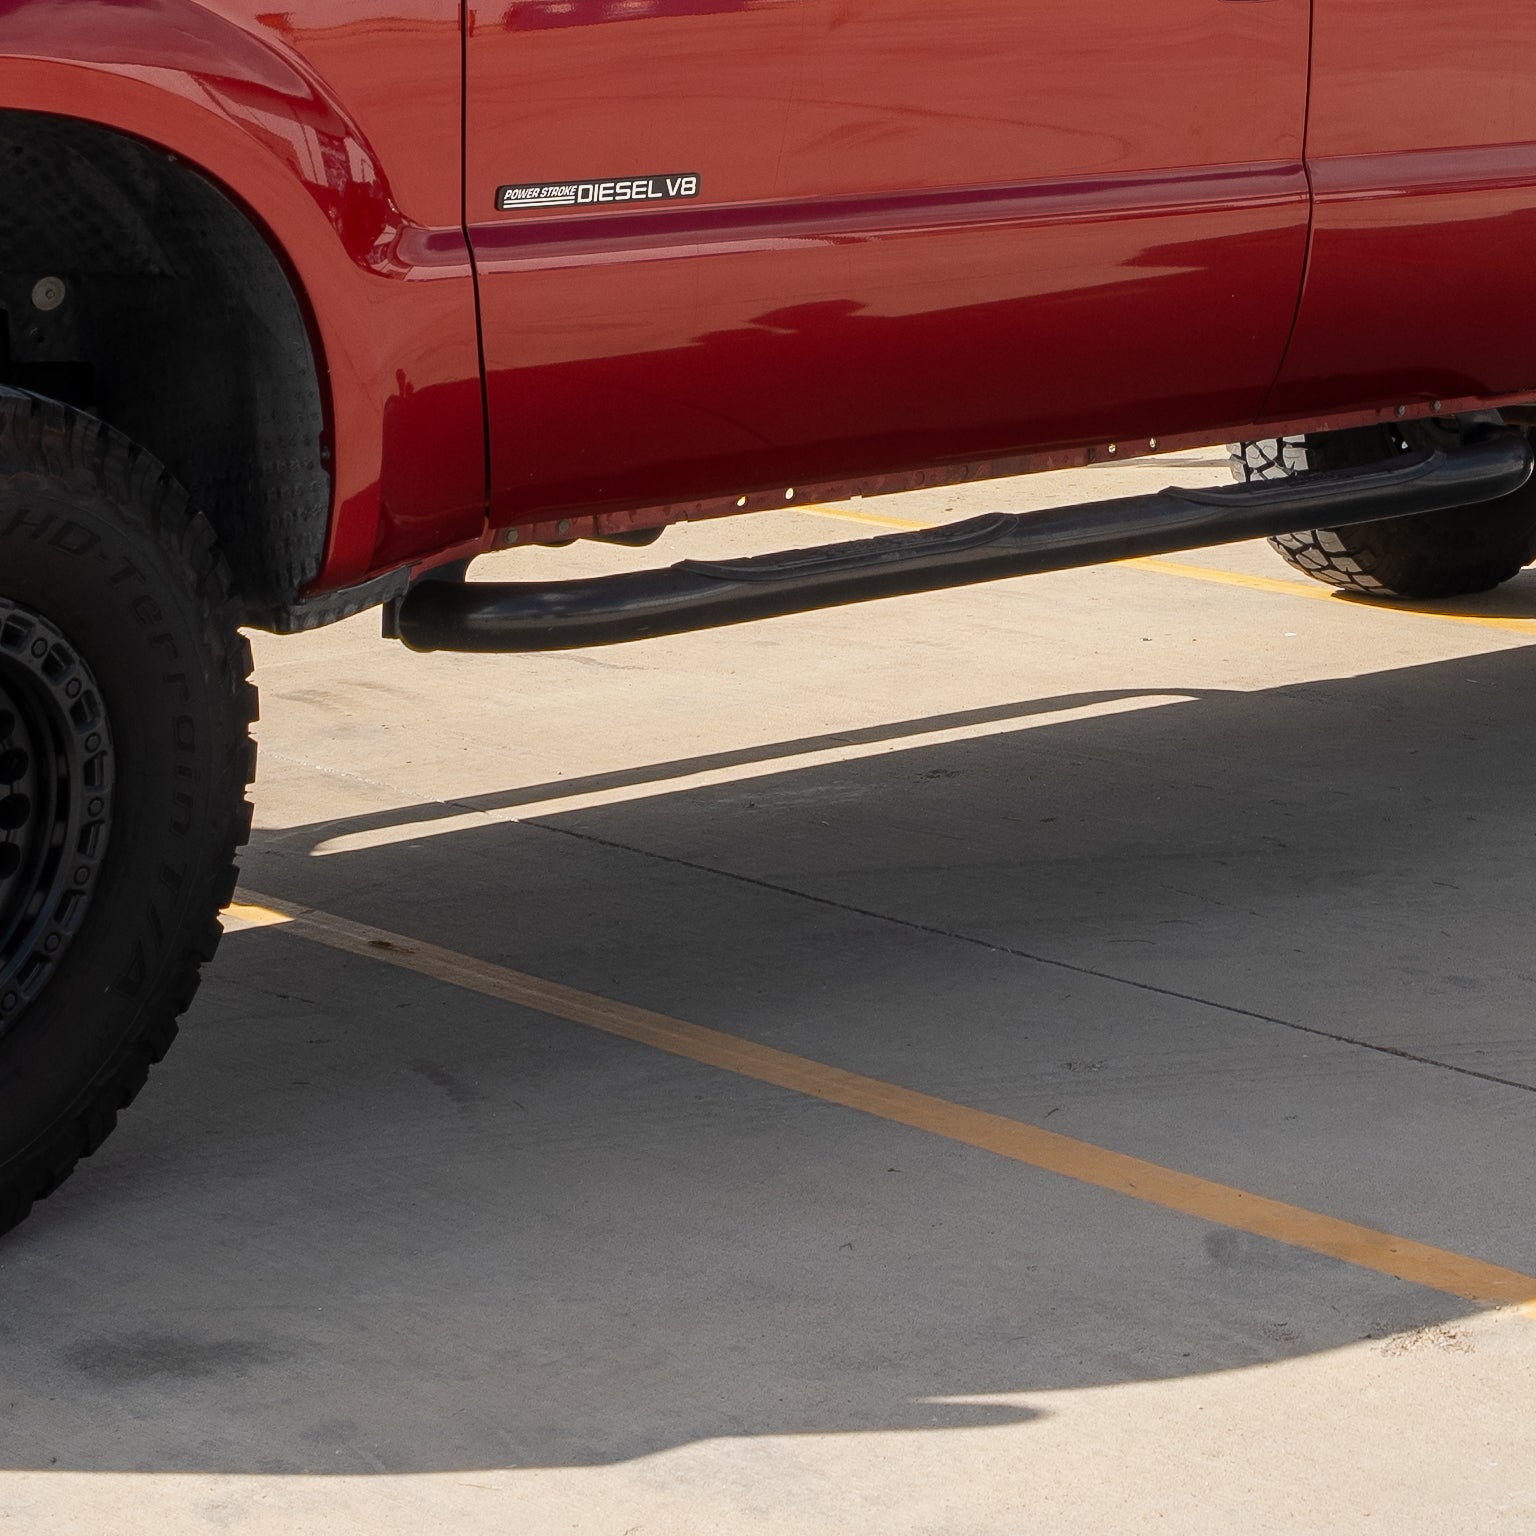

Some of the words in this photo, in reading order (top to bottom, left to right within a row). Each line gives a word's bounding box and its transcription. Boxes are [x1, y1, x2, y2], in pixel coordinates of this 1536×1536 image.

[504, 187, 539, 200] POWER
[541, 185, 577, 198] STROKE
[577, 180, 662, 203] DIESEL
[666, 177, 697, 196] V8
